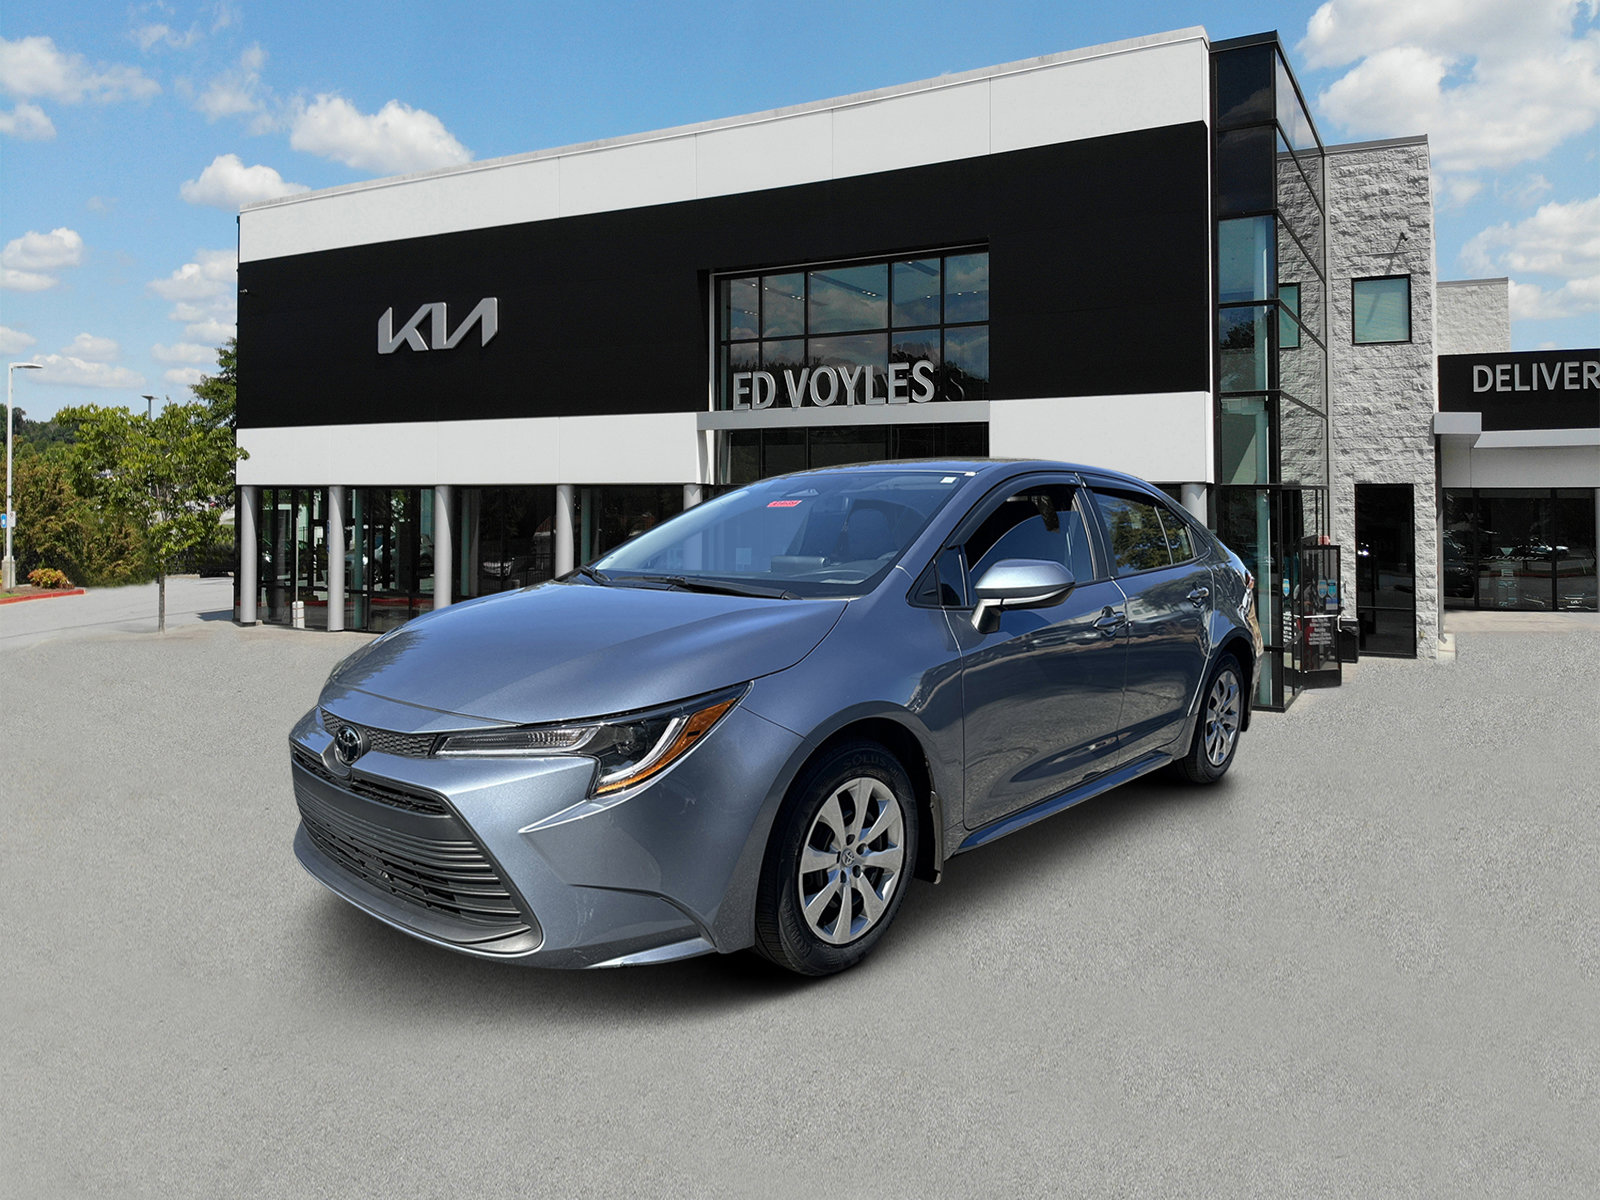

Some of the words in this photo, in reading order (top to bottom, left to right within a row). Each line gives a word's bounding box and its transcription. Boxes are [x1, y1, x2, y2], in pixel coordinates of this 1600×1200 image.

[377, 297, 498, 354] KIA
[733, 371, 776, 411] ED
[784, 360, 936, 409] VOYLES
[1473, 360, 1600, 393] DELIVER
